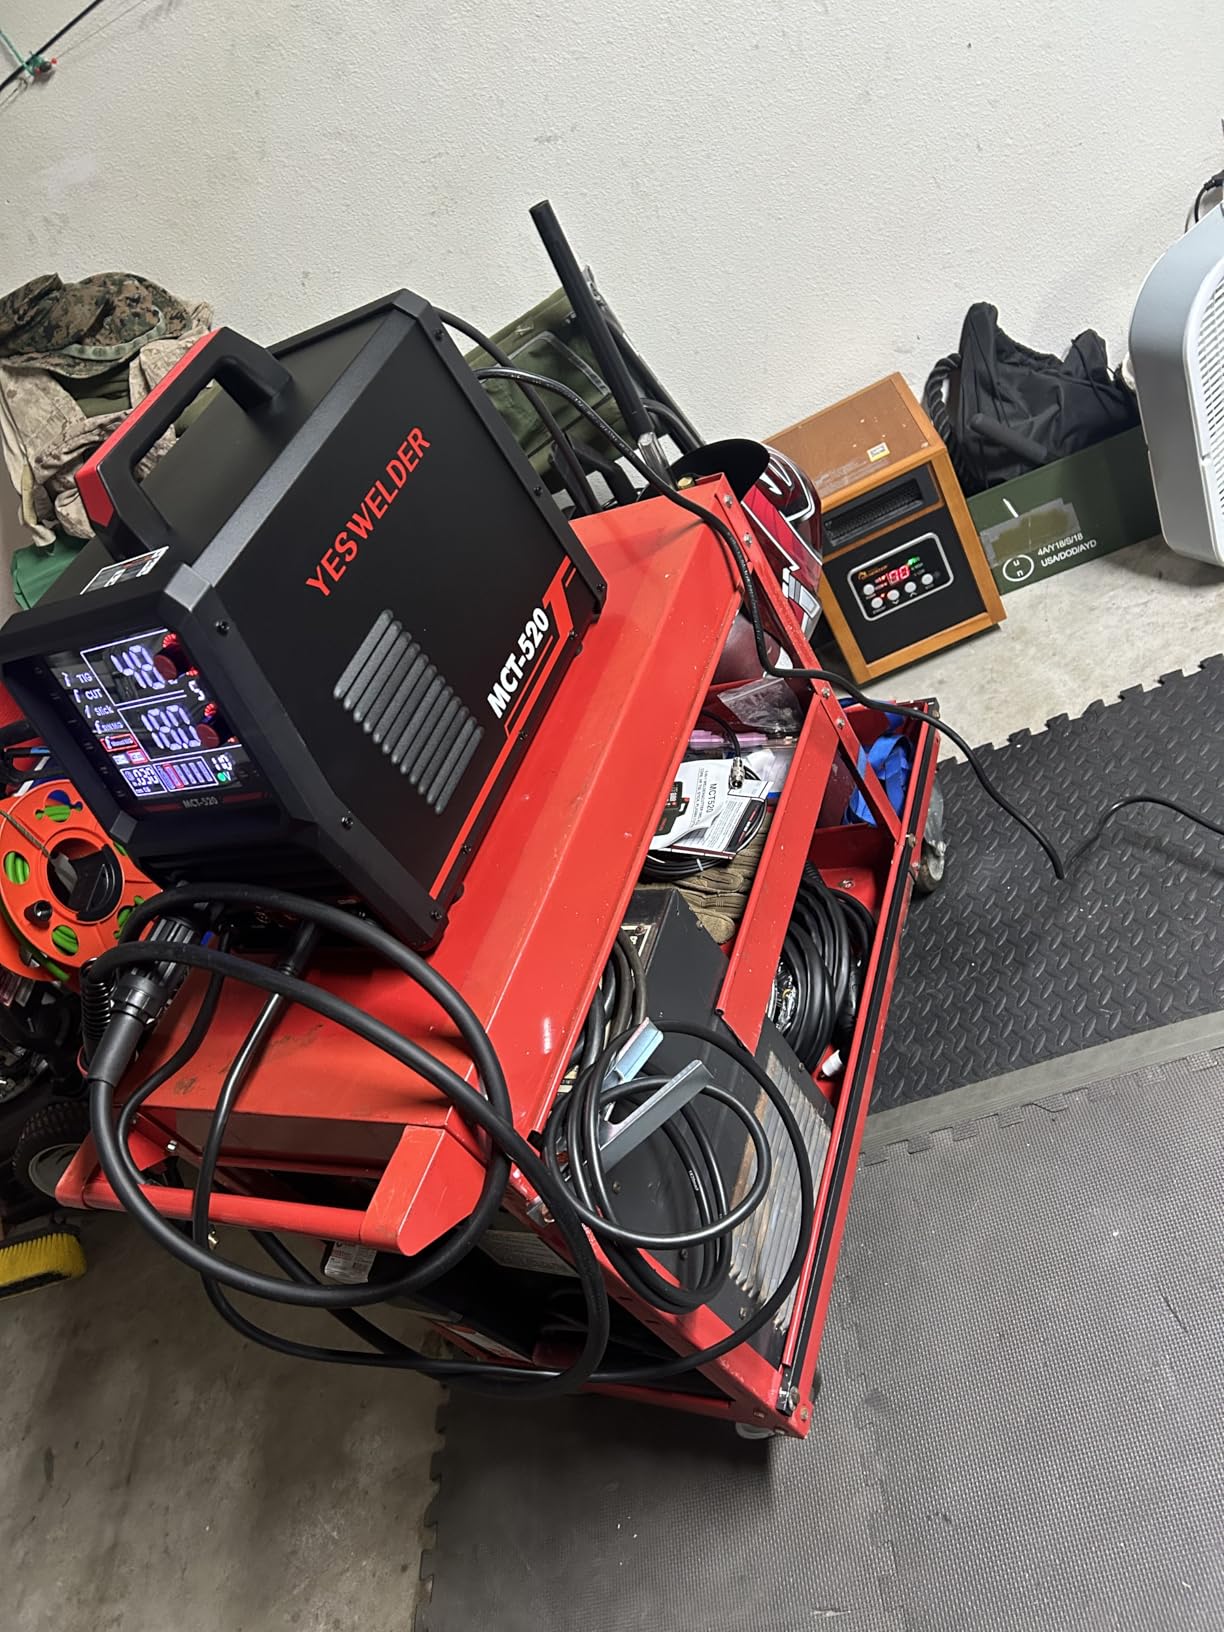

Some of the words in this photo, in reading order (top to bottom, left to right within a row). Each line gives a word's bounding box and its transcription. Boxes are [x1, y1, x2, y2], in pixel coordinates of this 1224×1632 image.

[305, 426, 431, 597] YESWELDER
[1037, 532, 1084, 556] 4A/Y18/S/18
[1040, 539, 1097, 567] USA/DOD/AYD
[487, 607, 549, 719] MCT-520
[76, 672, 93, 684] TIG
[85, 688, 103, 700] CUT
[94, 704, 114, 717] Stick
[182, 796, 218, 809] MCT-520
[706, 783, 717, 813] MCT520
